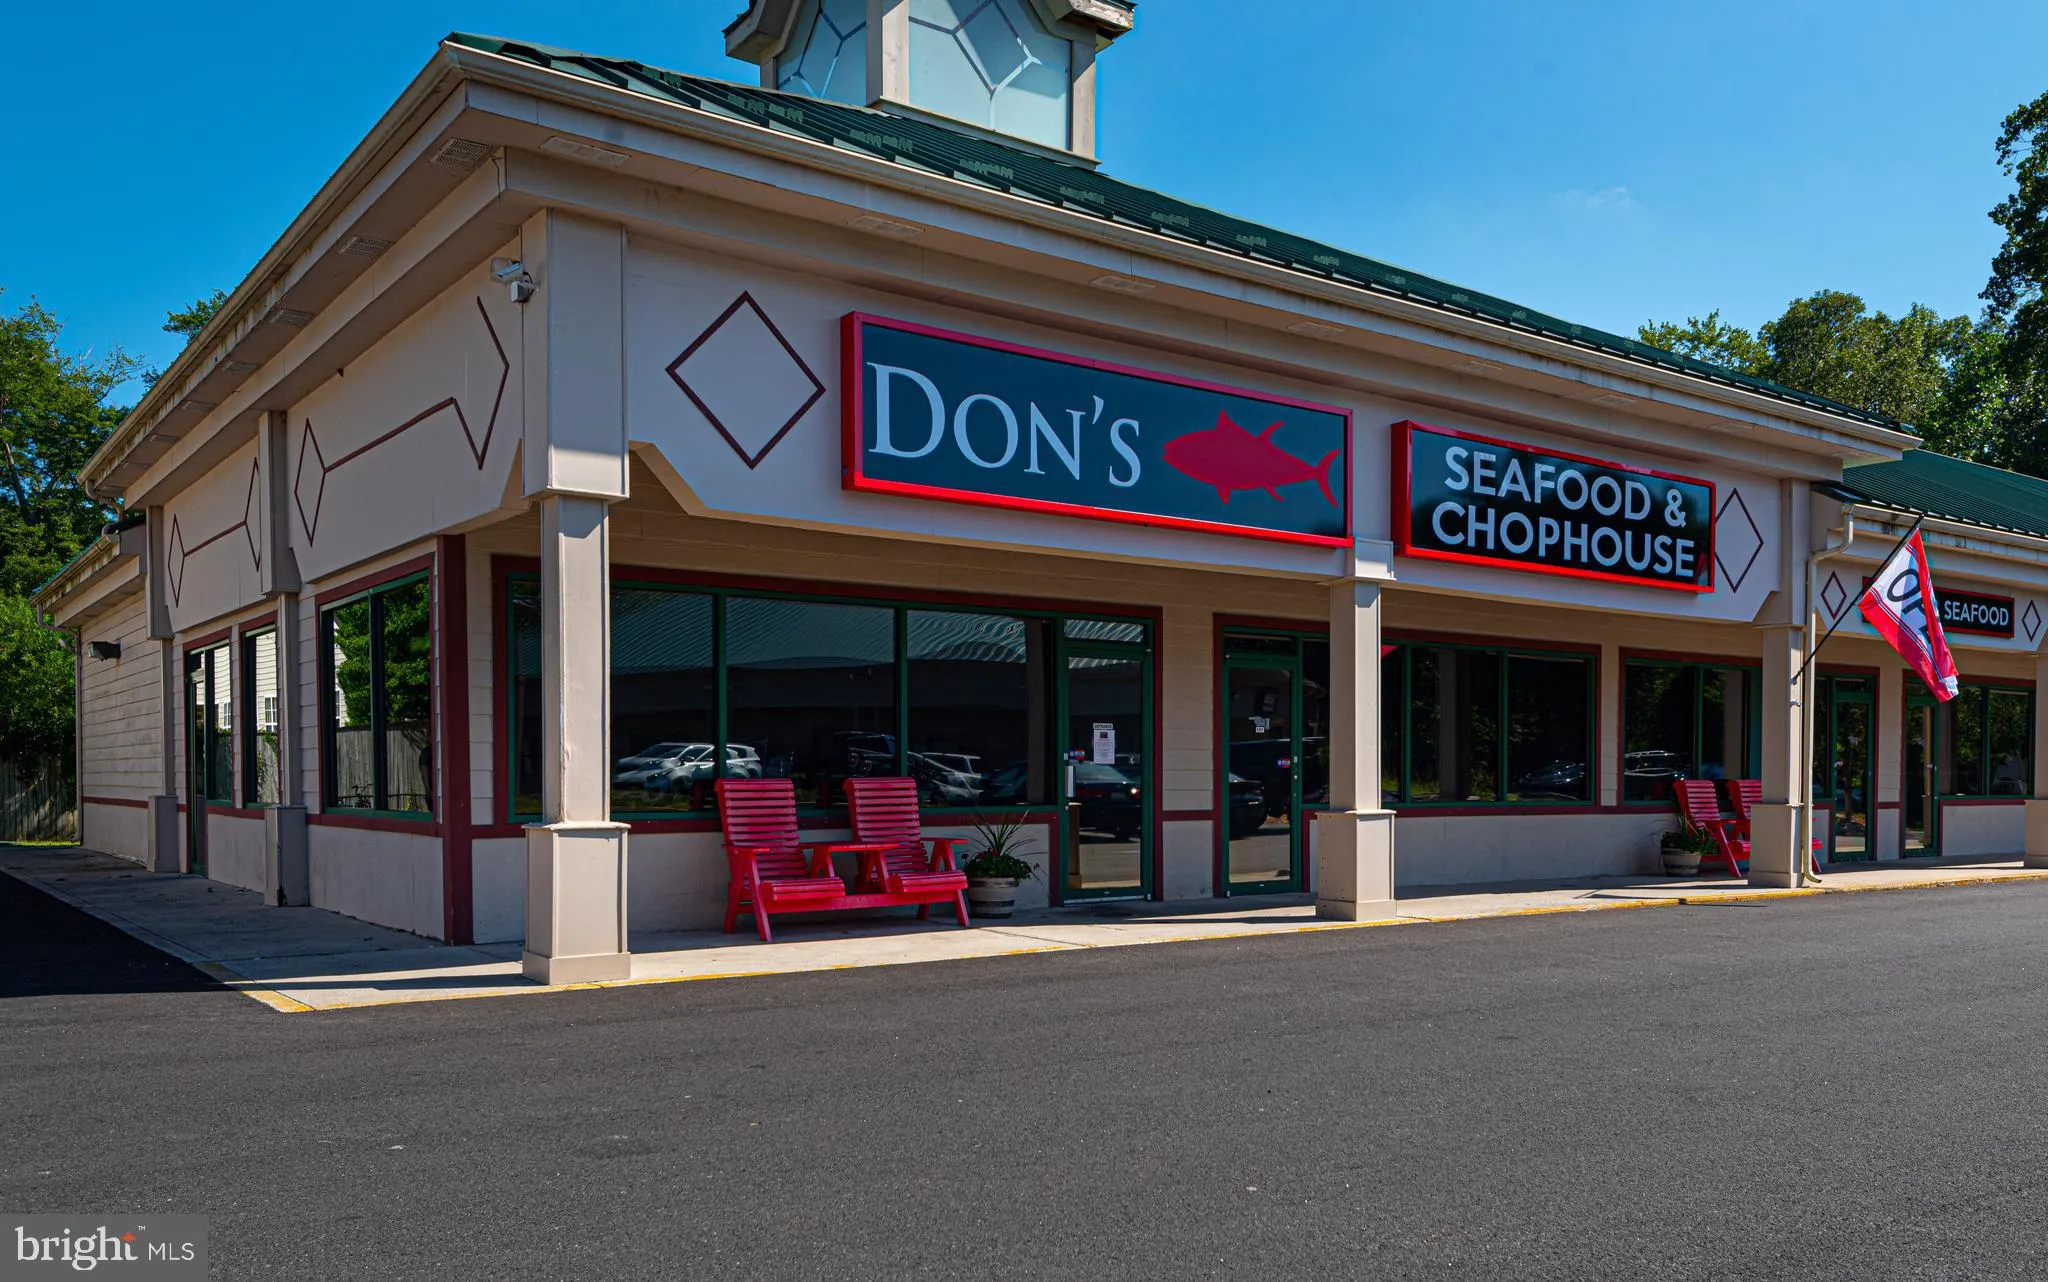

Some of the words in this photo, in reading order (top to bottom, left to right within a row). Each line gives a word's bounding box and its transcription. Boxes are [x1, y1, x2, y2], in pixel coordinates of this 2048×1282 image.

[866, 361, 1142, 488] DON'S
[1444, 446, 1651, 521] SEAFOOD
[1663, 488, 1687, 528] &
[1431, 501, 1695, 578] CHOPHOUSE
[1943, 600, 2009, 626] SEAFOOD
